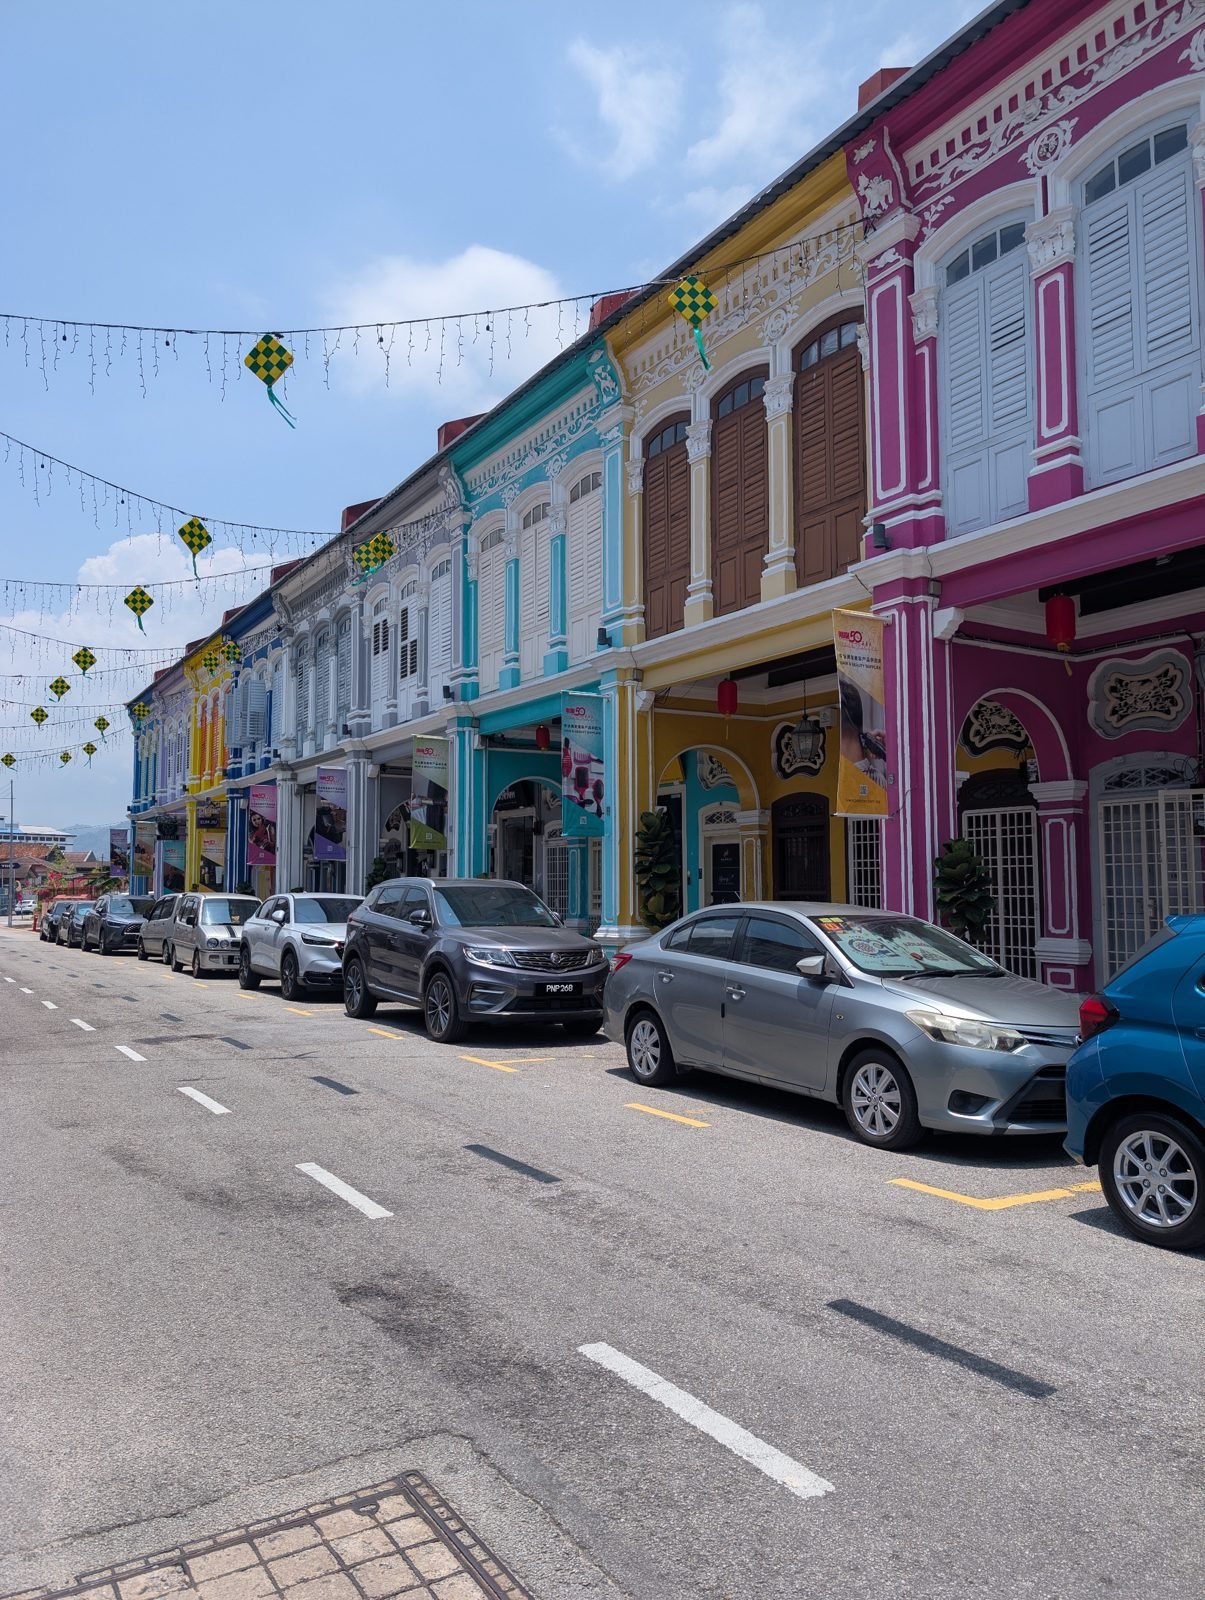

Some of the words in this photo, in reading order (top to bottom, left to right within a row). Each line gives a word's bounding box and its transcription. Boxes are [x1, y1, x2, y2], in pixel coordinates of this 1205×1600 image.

[849, 630, 862, 643] 50
[574, 707, 586, 716] 50
[546, 984, 560, 992] PNP
[560, 984, 574, 992] 268
